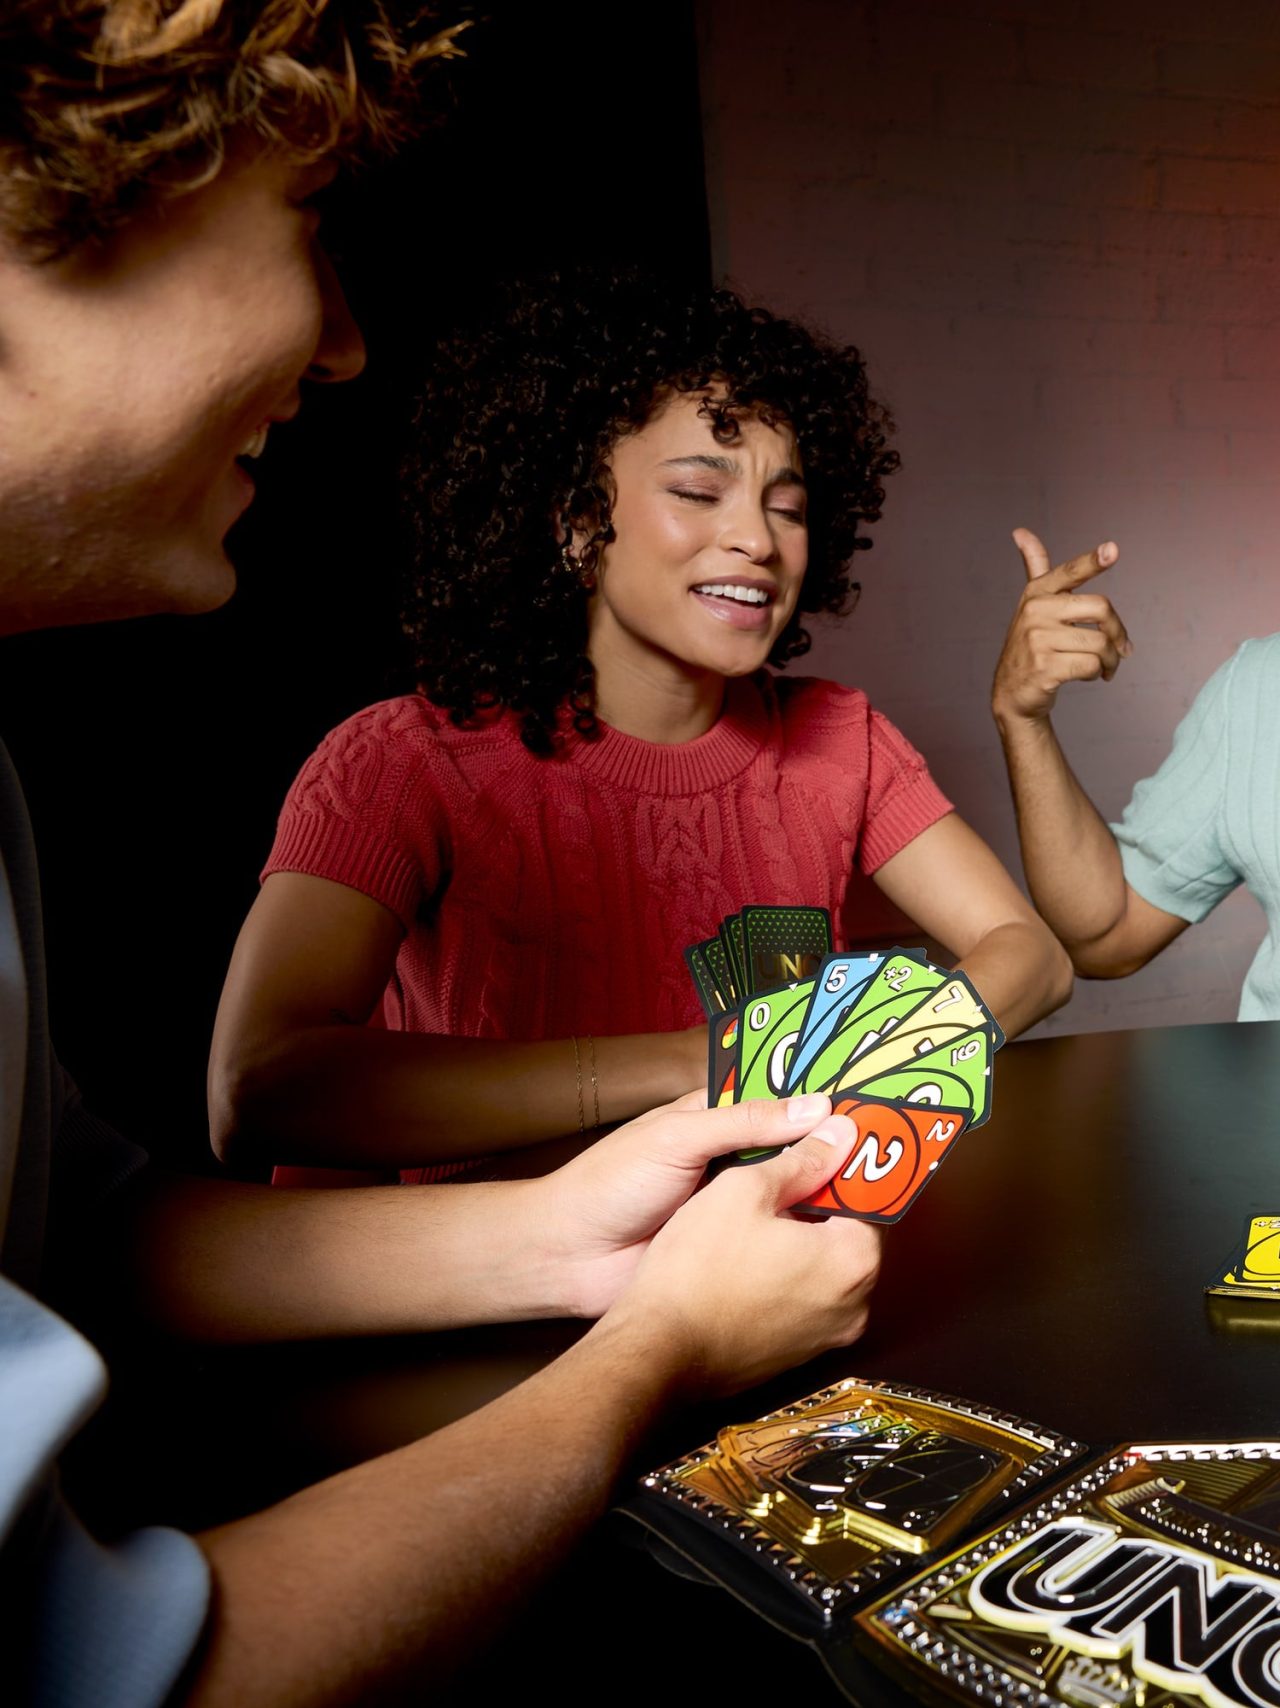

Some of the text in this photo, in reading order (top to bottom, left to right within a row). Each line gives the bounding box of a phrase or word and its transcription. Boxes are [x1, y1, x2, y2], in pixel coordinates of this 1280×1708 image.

[825, 964, 850, 993] 5
[932, 986, 963, 1013] 7
[749, 1002, 771, 1031] 0
[926, 1119, 955, 1142] 2
[841, 1132, 903, 1182] 2
